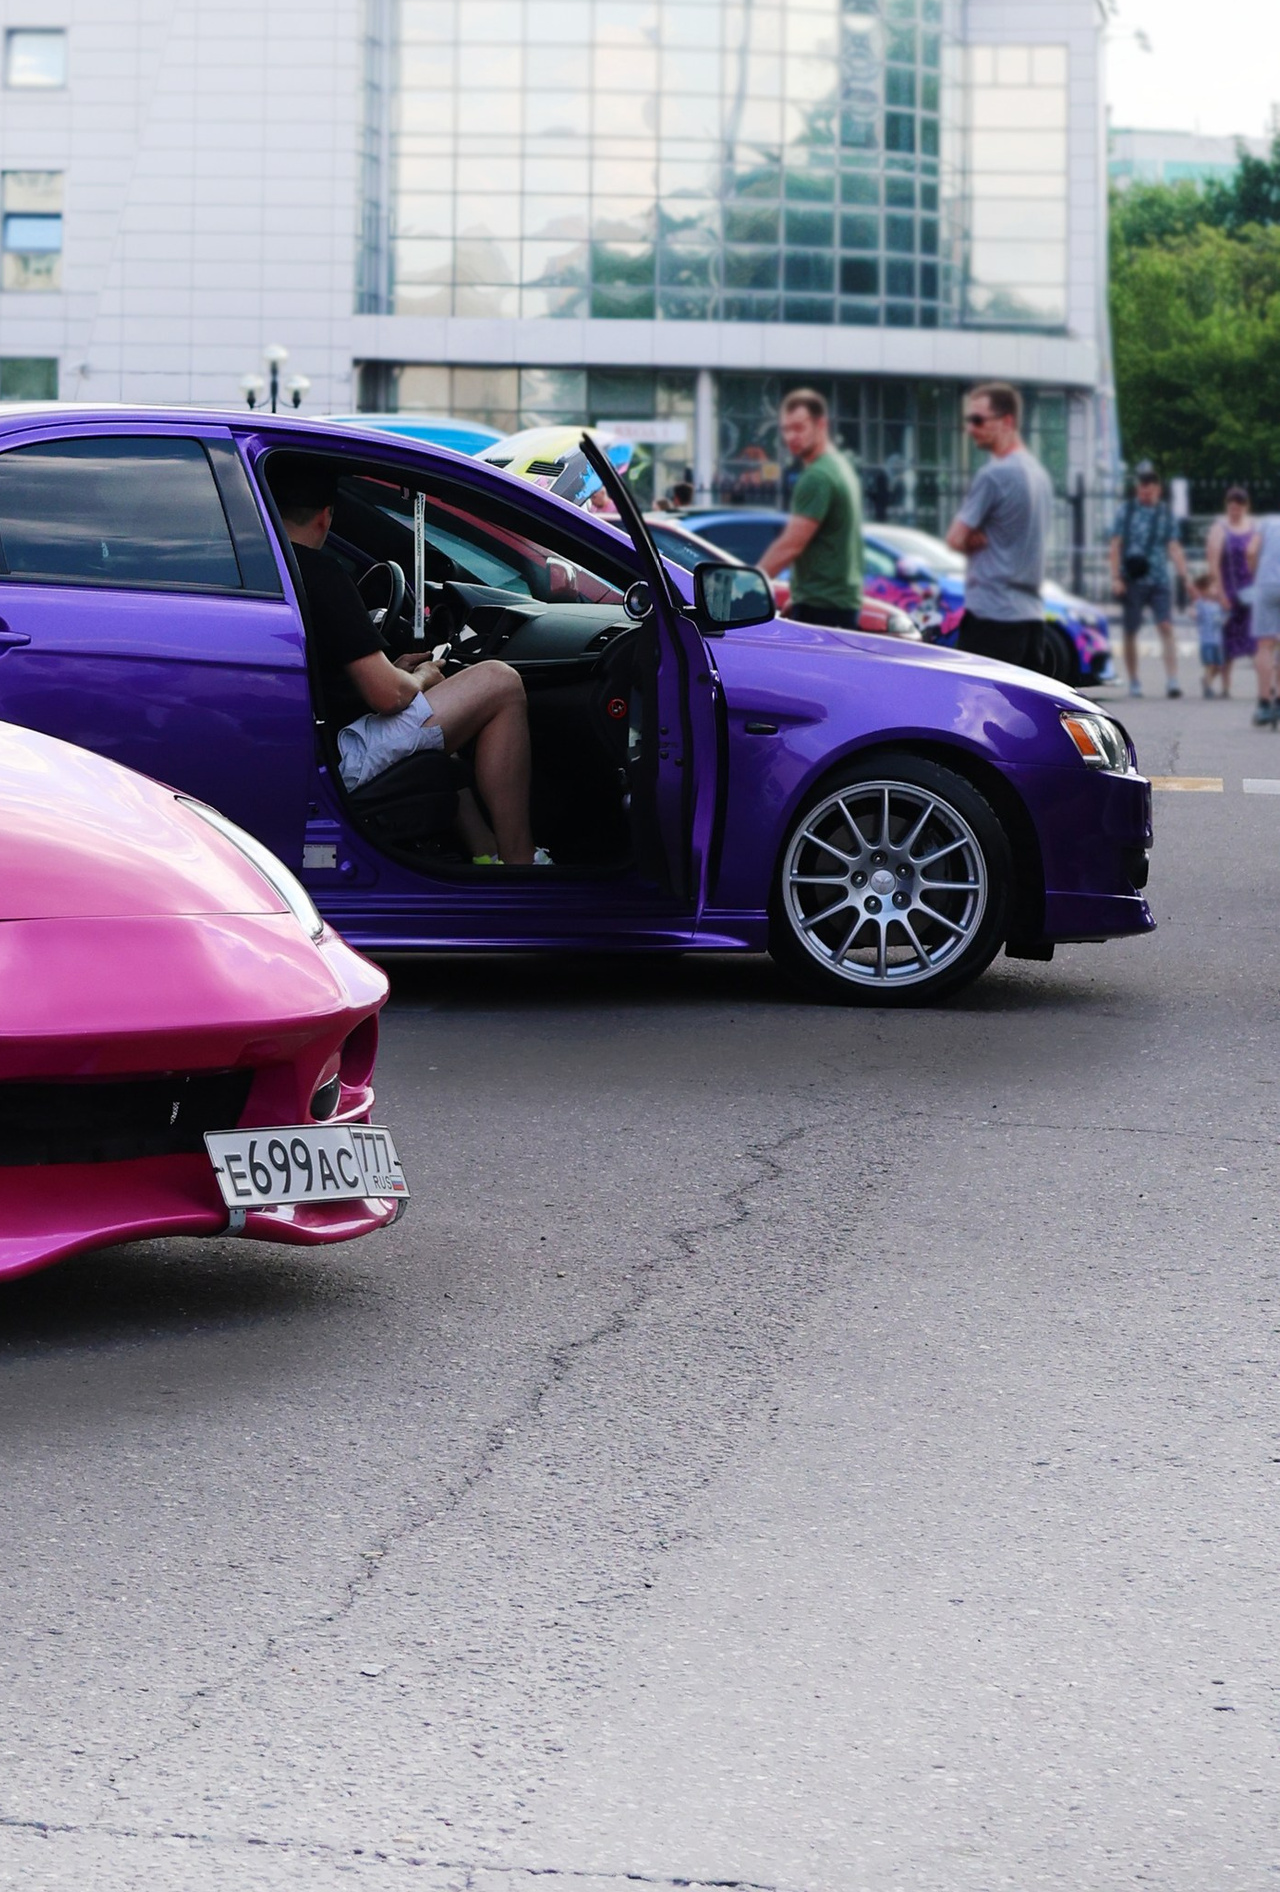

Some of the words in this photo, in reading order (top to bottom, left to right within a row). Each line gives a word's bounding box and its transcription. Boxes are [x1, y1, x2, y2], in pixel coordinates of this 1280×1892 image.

[224, 1137, 359, 1197] Е699АС
[353, 1133, 391, 1173] 777
[373, 1175, 392, 1190] RUS
